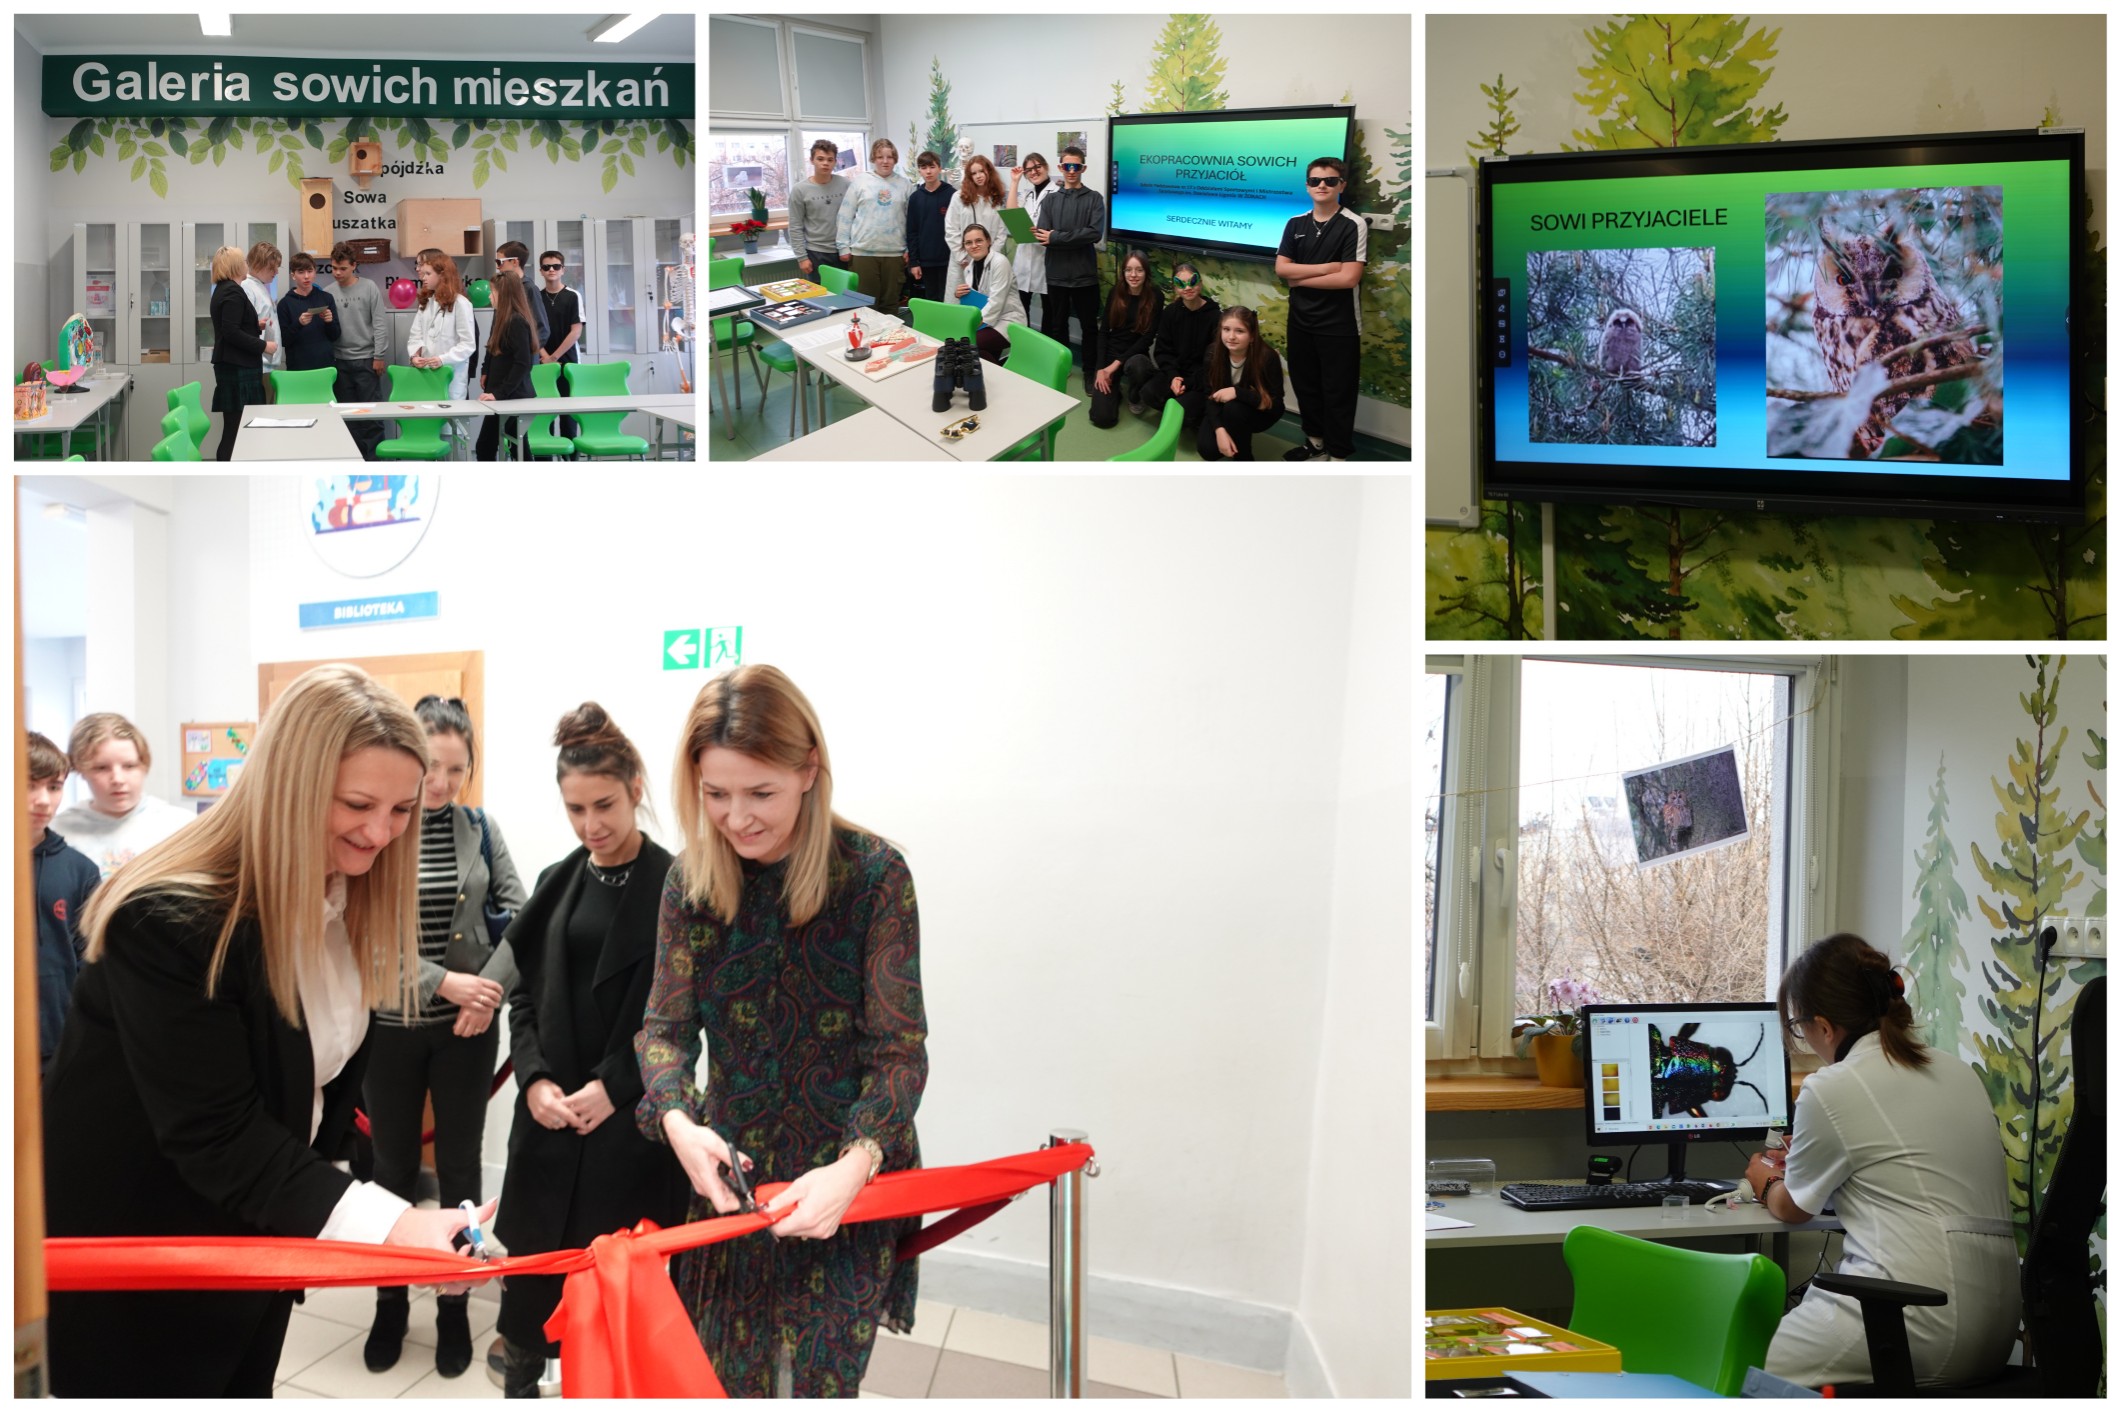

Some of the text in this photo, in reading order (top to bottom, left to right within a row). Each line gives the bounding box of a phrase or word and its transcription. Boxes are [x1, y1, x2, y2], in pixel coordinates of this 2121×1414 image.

[72, 61, 670, 108] Galeria sowich mieszkań
[1139, 154, 1298, 167] EKOPRACOWNIA SOWICH
[1175, 168, 1247, 181] PRZYJACIÓŁ
[343, 190, 387, 204] Sowa
[332, 216, 397, 230] uszatka
[1166, 215, 1253, 230] SERDECZNIE WITAMY
[1530, 208, 1728, 231] SOWI PRZYJACIELE
[334, 601, 405, 619] BIBLIOTEKA
